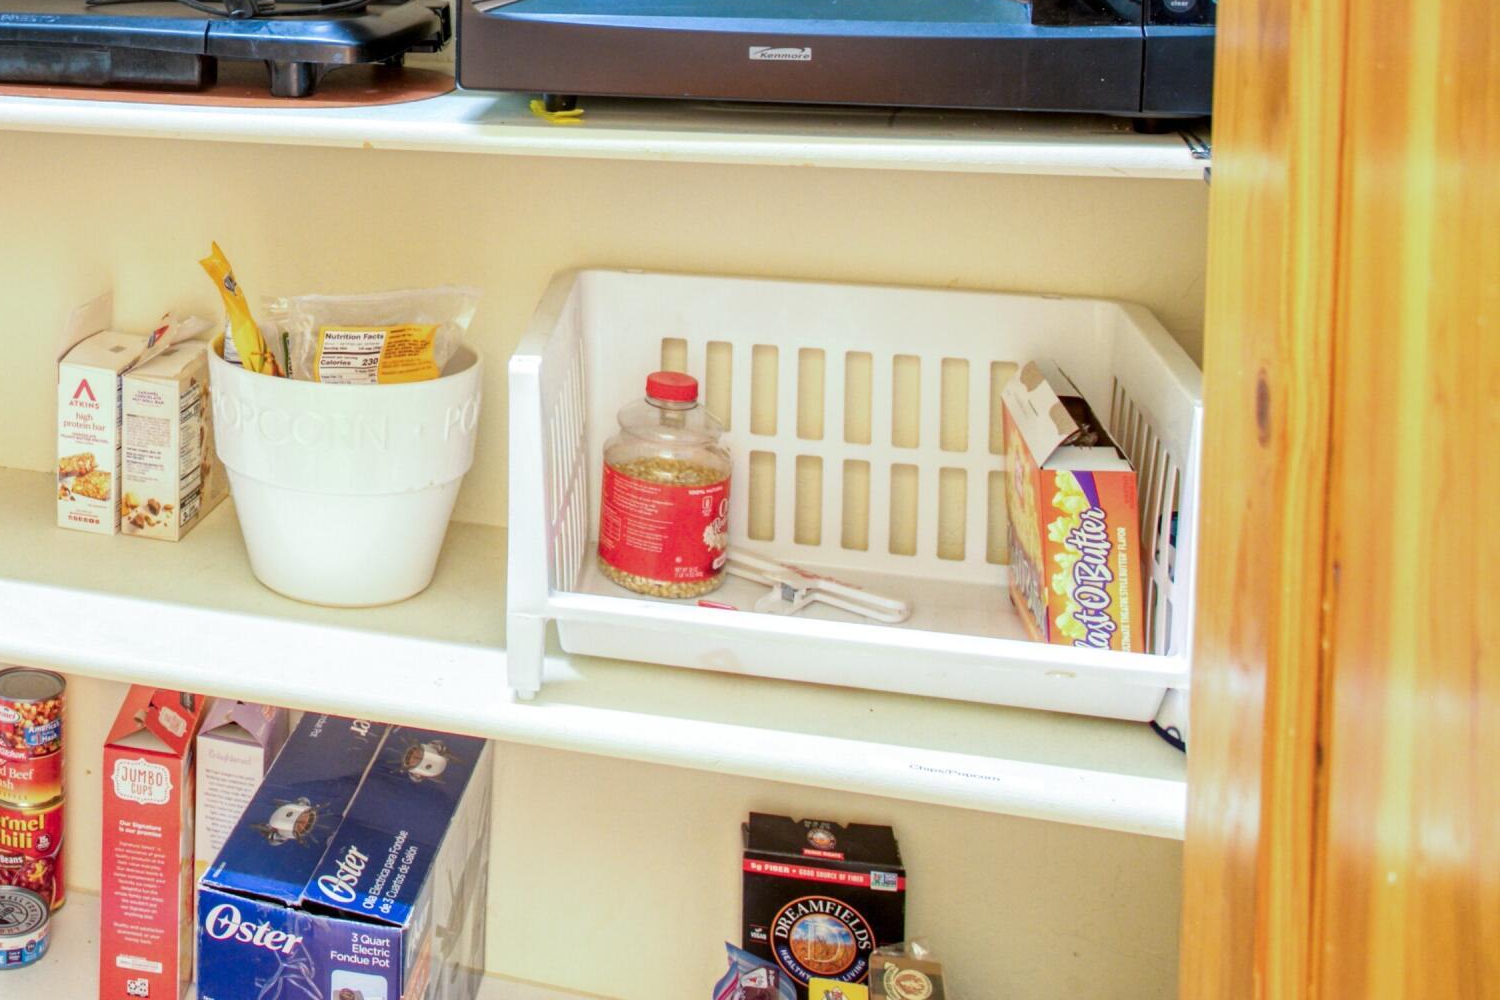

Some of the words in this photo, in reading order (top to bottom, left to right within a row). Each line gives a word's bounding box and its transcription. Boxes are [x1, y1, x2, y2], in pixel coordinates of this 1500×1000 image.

[325, 333, 361, 341] Nutrition
[363, 333, 384, 341] Facts
[361, 358, 379, 366] 230
[68, 401, 100, 410] ATKINS
[75, 411, 93, 421] high
[63, 420, 91, 431] protein
[92, 422, 106, 432] bar
[1064, 506, 1114, 586] Butter
[9, 767, 34, 780] Beef
[121, 766, 163, 787] JUMBO
[130, 783, 153, 796] CUPS
[119, 819, 131, 827] Our
[132, 820, 162, 832] Signature
[136, 828, 162, 838] promise
[0, 854, 23, 864] Beans
[318, 846, 369, 903] Oster
[764, 864, 790, 874] FIBER
[206, 904, 303, 954] Oster
[775, 899, 871, 950] DREAMFIELDS
[352, 932, 358, 942] 3
[360, 934, 390, 946] Quart
[352, 944, 390, 957] Electric
[331, 952, 369, 965] Fondue
[371, 956, 390, 968] Pot
[842, 959, 866, 982] LIVING
